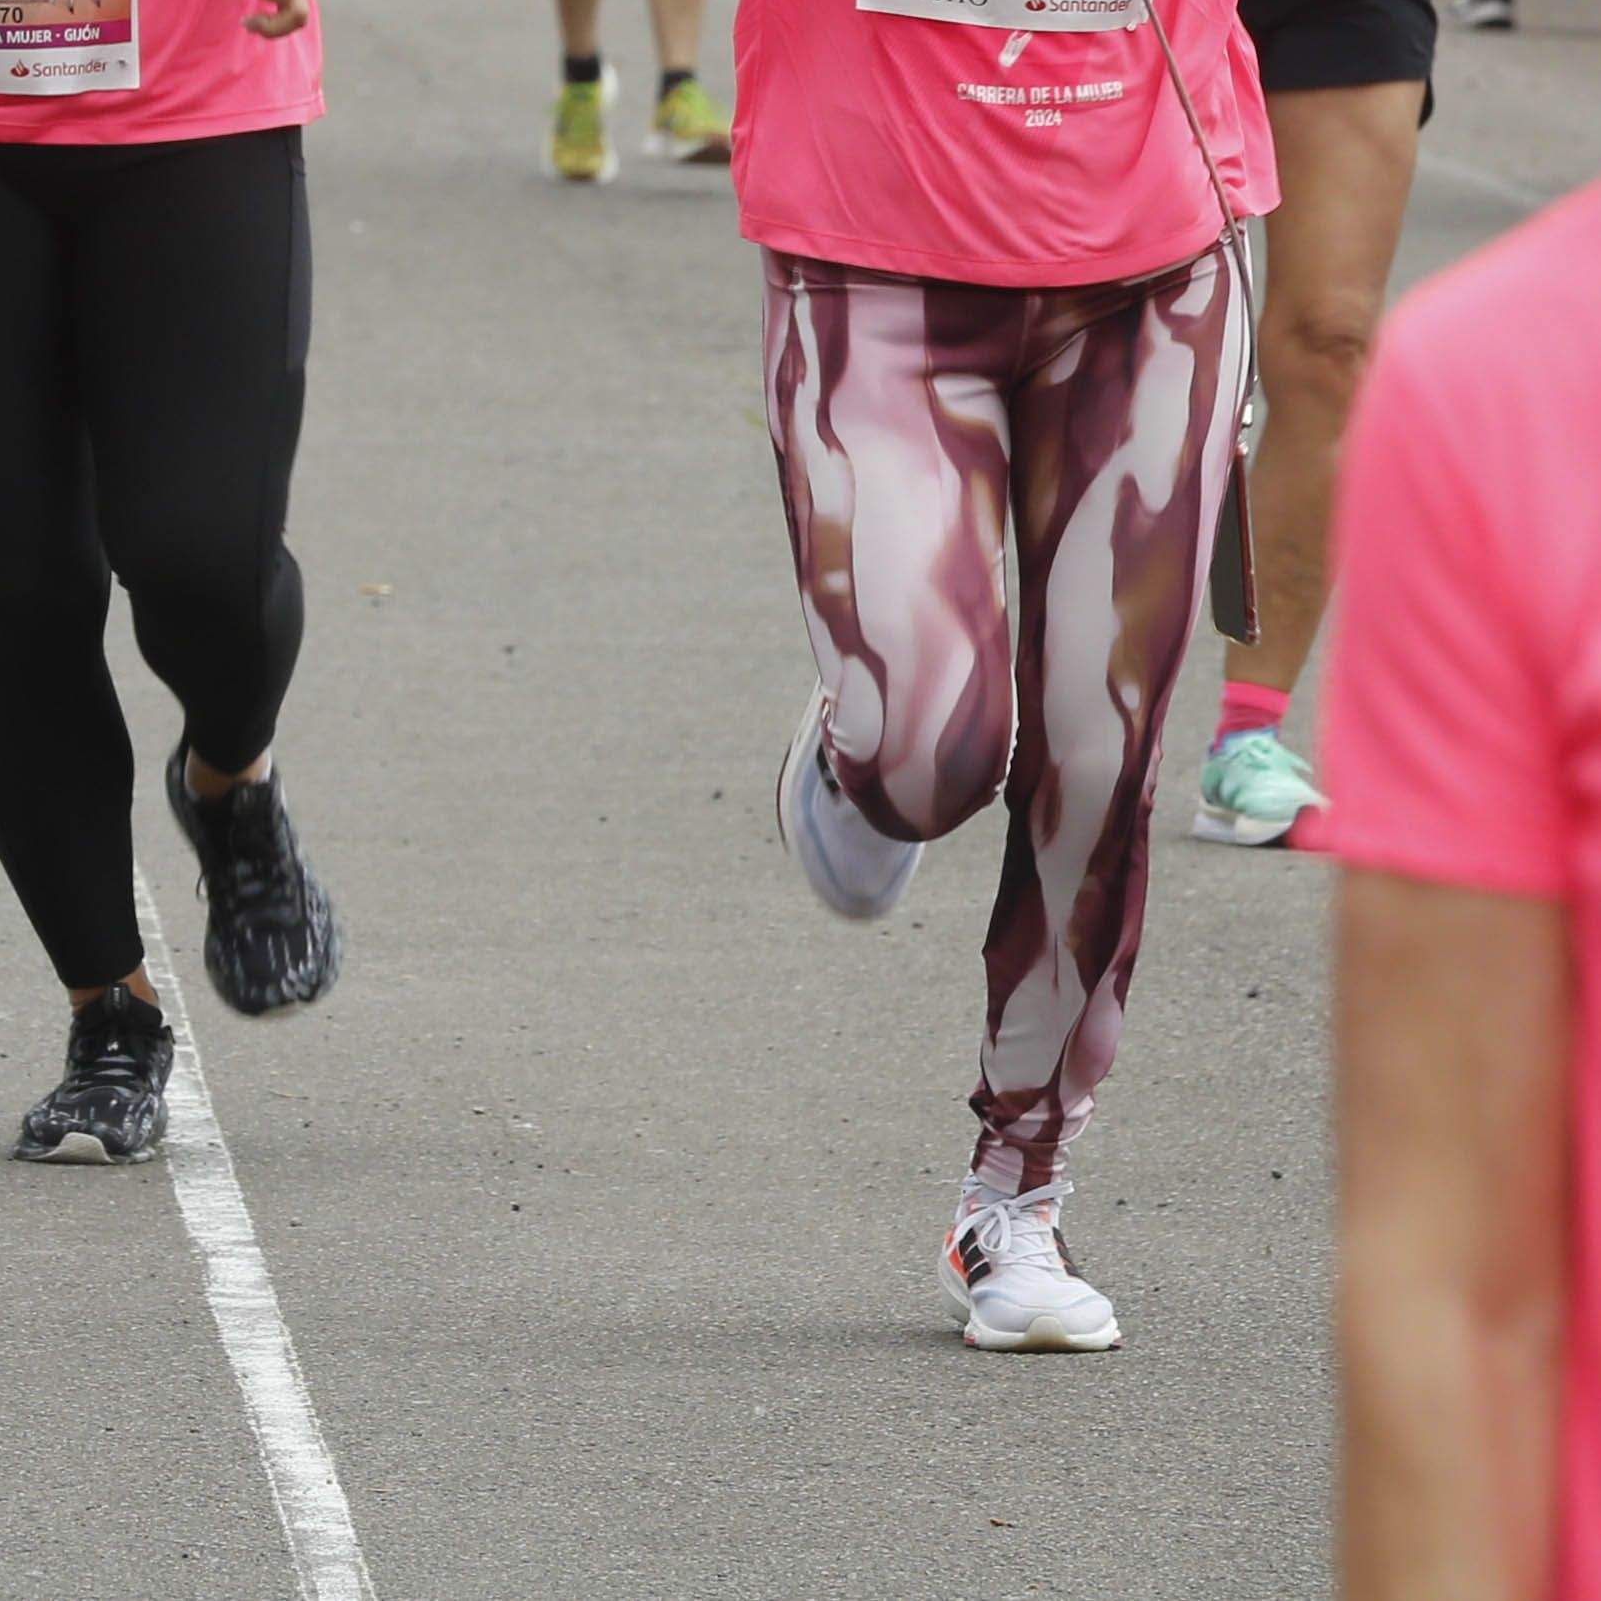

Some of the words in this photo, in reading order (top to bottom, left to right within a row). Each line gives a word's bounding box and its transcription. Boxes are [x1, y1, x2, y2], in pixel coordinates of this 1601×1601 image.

[6, 28, 52, 44] MUJER
[64, 24, 100, 42] GIJÓN
[32, 59, 108, 78] Santander
[957, 82, 1026, 105] CARRERA
[1030, 85, 1052, 105] DE
[1054, 85, 1073, 104] LA
[1024, 108, 1063, 128] 2024
